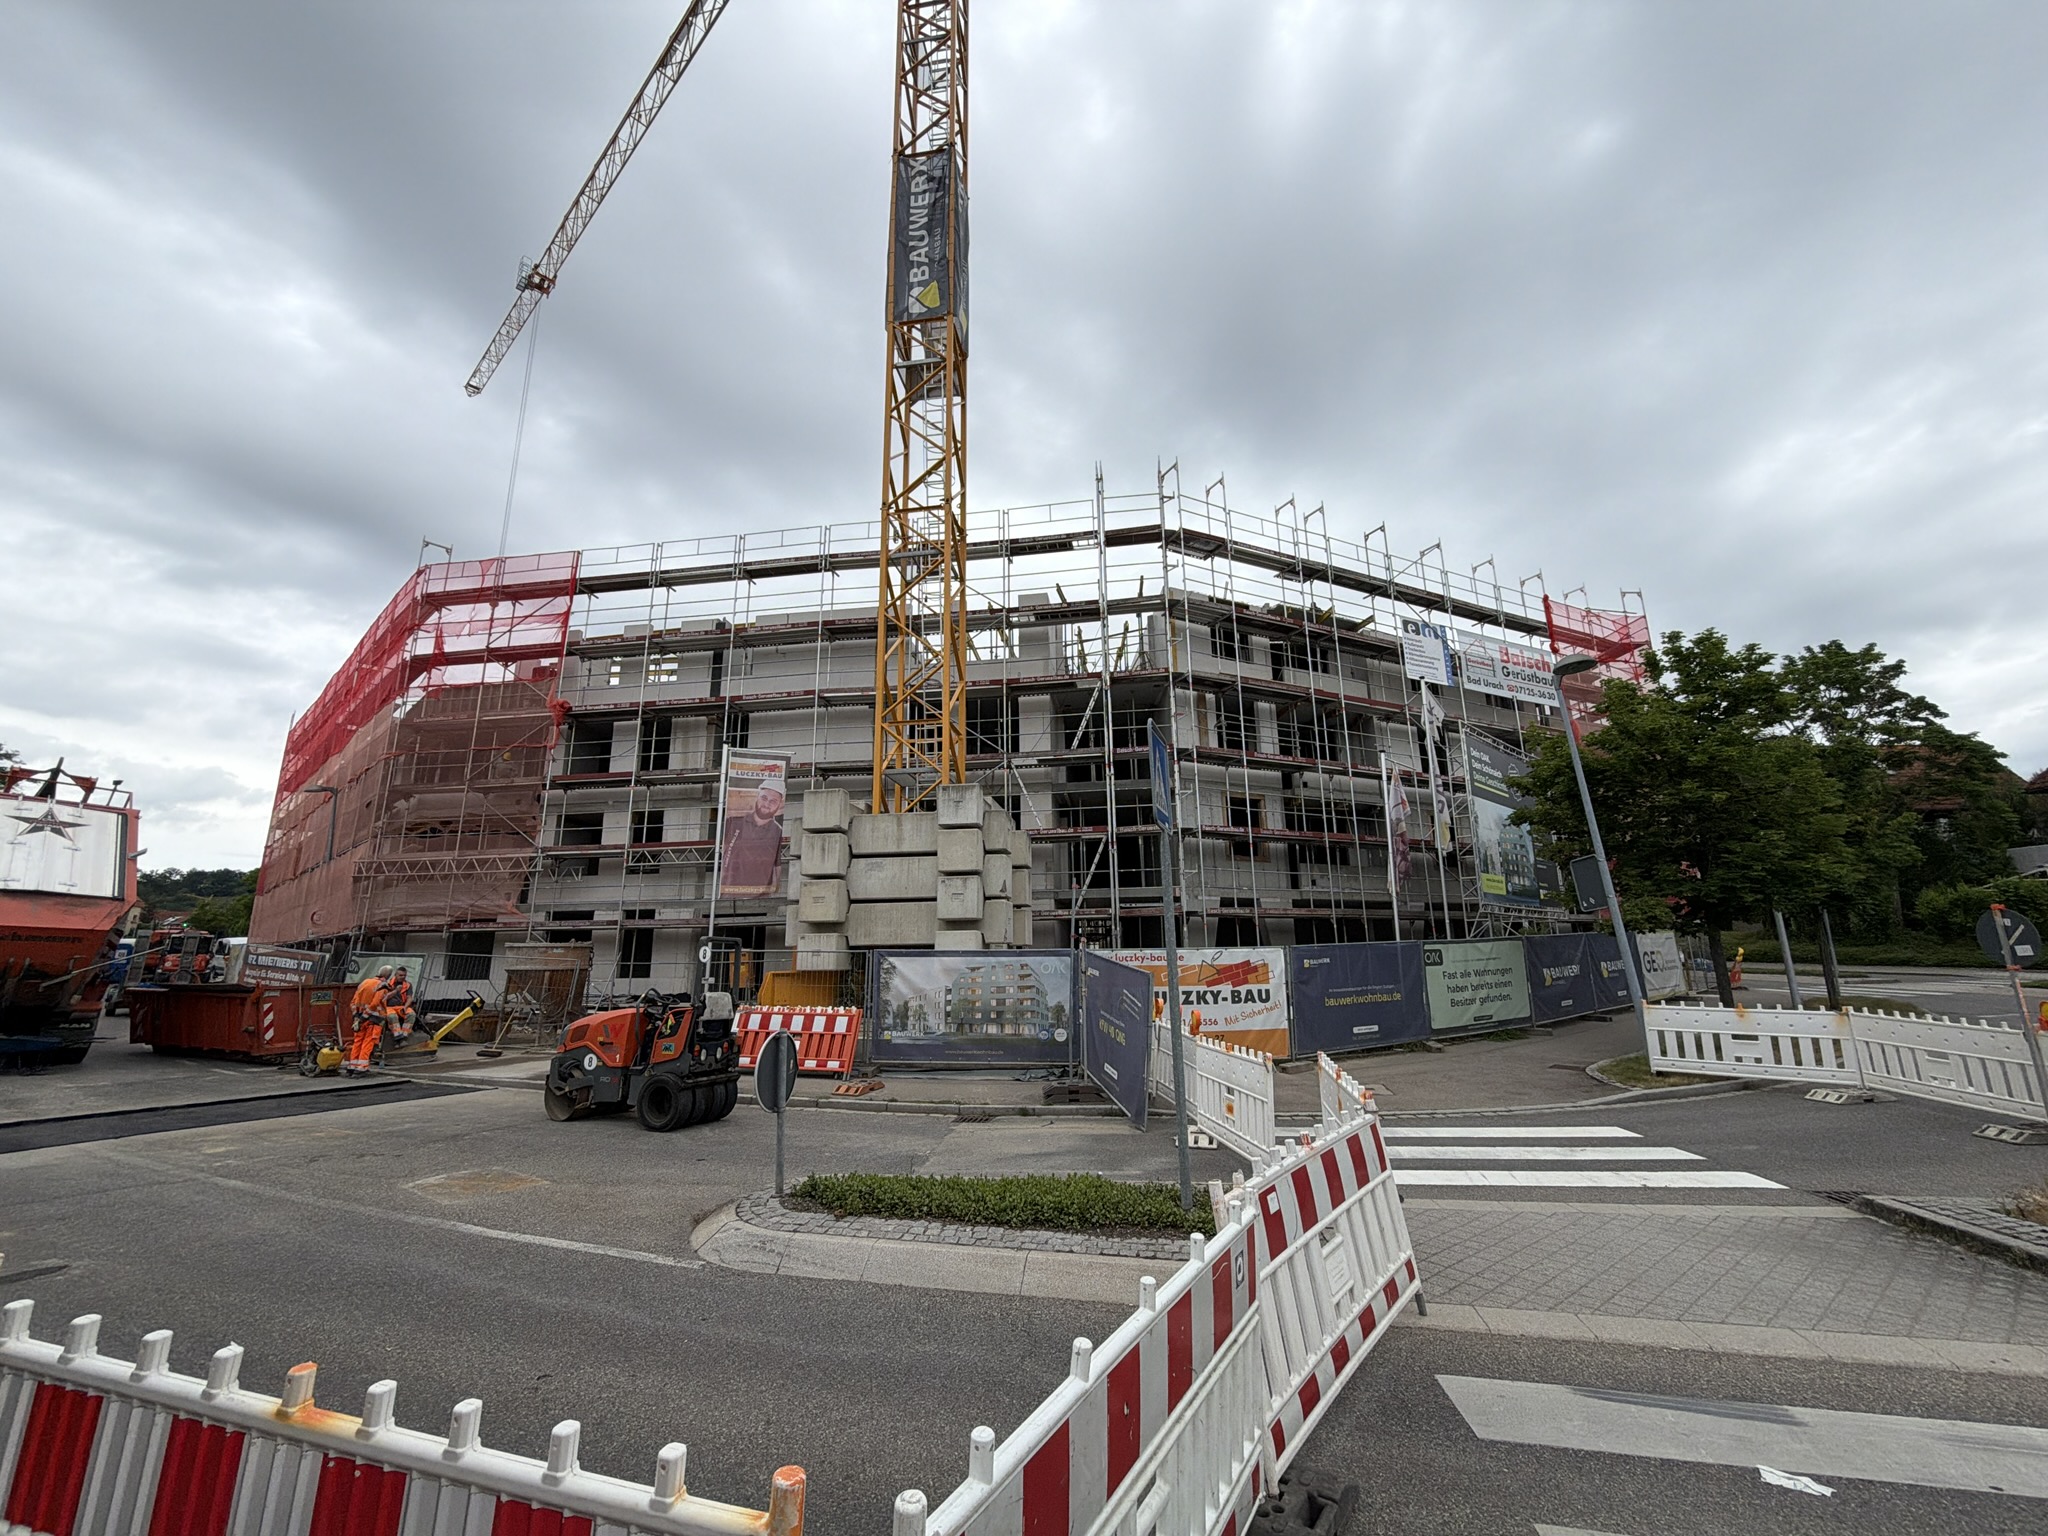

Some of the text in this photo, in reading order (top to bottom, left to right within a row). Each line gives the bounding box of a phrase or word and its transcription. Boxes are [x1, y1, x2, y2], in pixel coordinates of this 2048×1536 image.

[908, 157, 930, 283] BAUWERK
[1499, 645, 1552, 673] Baisch
[1466, 675, 1504, 691] Bad Urach
[1502, 665, 1554, 687] Gerüstbau
[736, 770, 783, 779] LUCZKY-BAU
[1442, 967, 1513, 980] Fast alle Wohnungen
[1446, 979, 1513, 994] haben bereits einen
[1325, 991, 1402, 1007] bauwerkwohnbau.de
[1450, 993, 1512, 1008] Besitzer gefunden.
[1224, 1000, 1282, 1027] Mit Sicherheit!
